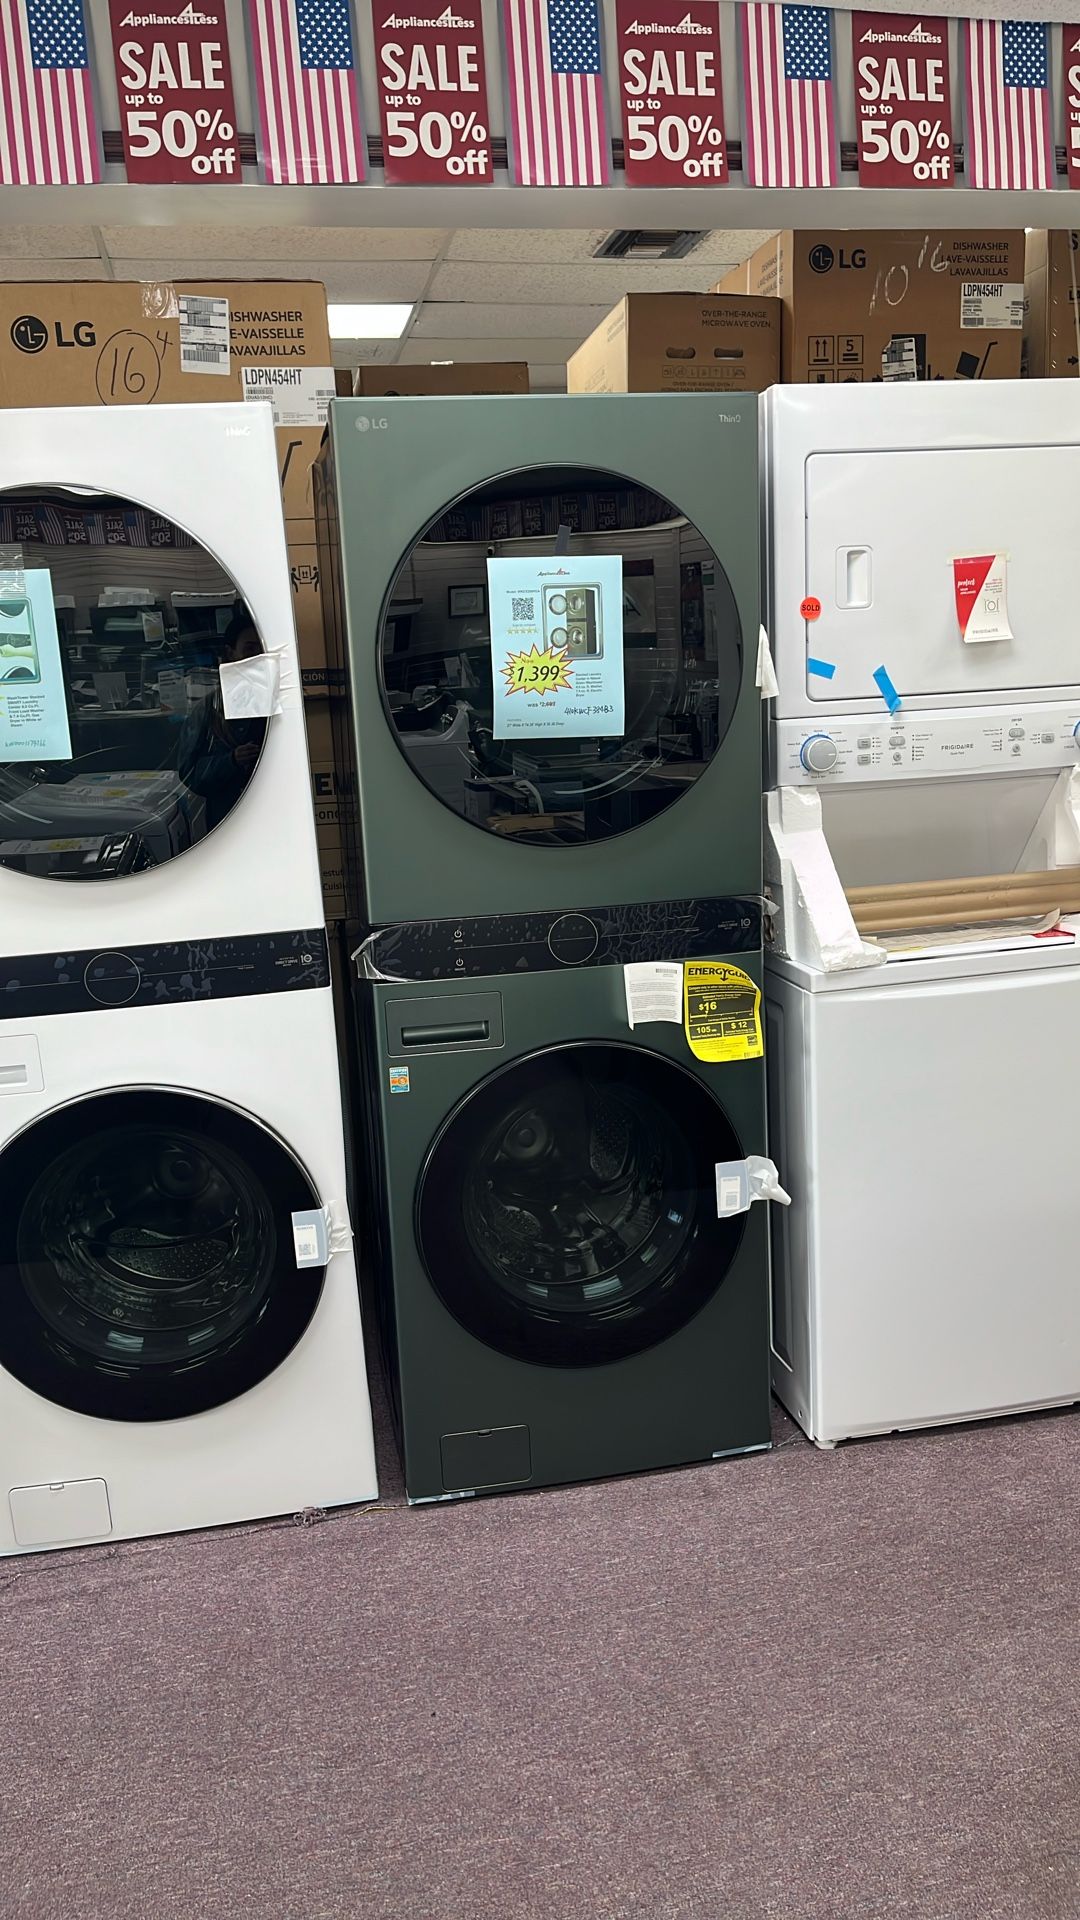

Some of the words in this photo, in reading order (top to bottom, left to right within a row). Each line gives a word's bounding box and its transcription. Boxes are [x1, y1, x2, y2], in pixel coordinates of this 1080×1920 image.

[119, 41, 225, 90] SALE
[380, 42, 480, 92] SALE
[623, 48, 716, 97] SALE
[858, 56, 945, 103] SALE
[125, 93, 145, 107] up
[146, 92, 163, 105] to
[385, 94, 404, 108] up
[406, 93, 422, 106] to
[626, 99, 644, 112] up
[646, 98, 661, 110] to
[860, 104, 878, 117] up
[879, 103, 893, 115] to
[126, 109, 234, 158] 50%
[386, 111, 487, 159] 50%
[627, 115, 722, 162] 50%
[861, 119, 950, 164] 50%
[191, 147, 236, 175] off
[446, 149, 489, 176] off
[682, 152, 723, 178] off
[913, 155, 951, 180] off
[953, 242, 1009, 251] DISHWASHER
[839, 248, 866, 269] LG
[941, 254, 1009, 264] LAVE-VAISSELLE
[950, 268, 1009, 277] LAVAVAJILLAS
[963, 284, 1004, 297] LDPN454HT
[229, 311, 303, 322] ISHWASHER
[702, 310, 768, 318] OVER-THE-RANGE
[702, 320, 749, 328] MICROWAVE
[750, 320, 771, 328] OVEN
[55, 321, 96, 347] LG
[230, 328, 304, 339] E-VAISSELLE
[230, 345, 306, 356] AVAVAJILLAS
[846, 339, 854, 352] 5
[244, 369, 302, 385] LDPN454HT
[372, 418, 388, 429] LG
[801, 604, 821, 612] SOLD
[303, 671, 325, 681] CIÓN
[698, 1001, 717, 1011] $16
[696, 1026, 711, 1034] 105
